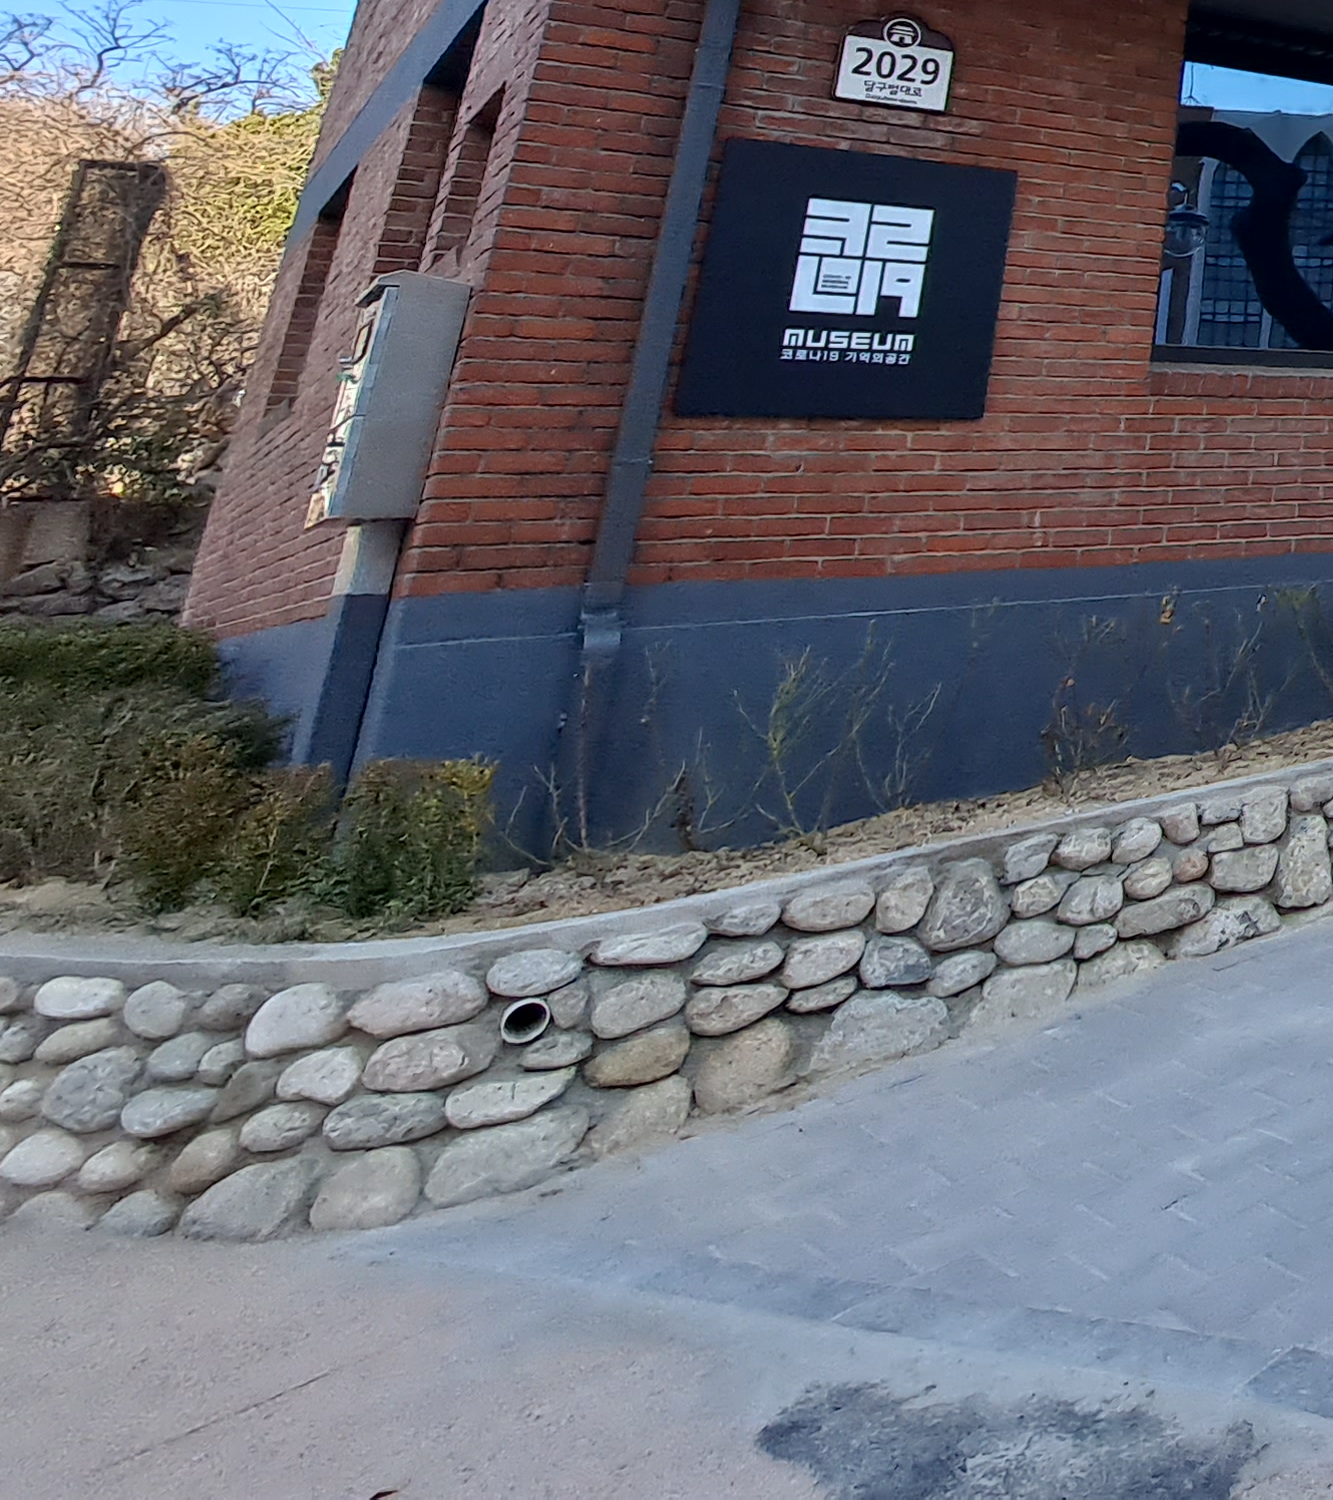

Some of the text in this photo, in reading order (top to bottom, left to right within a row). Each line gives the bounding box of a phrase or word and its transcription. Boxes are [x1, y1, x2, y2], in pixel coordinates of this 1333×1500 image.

[851, 47, 940, 85] 2029
[782, 328, 915, 351] MUSEUM
[780, 349, 839, 362] 코로나19
